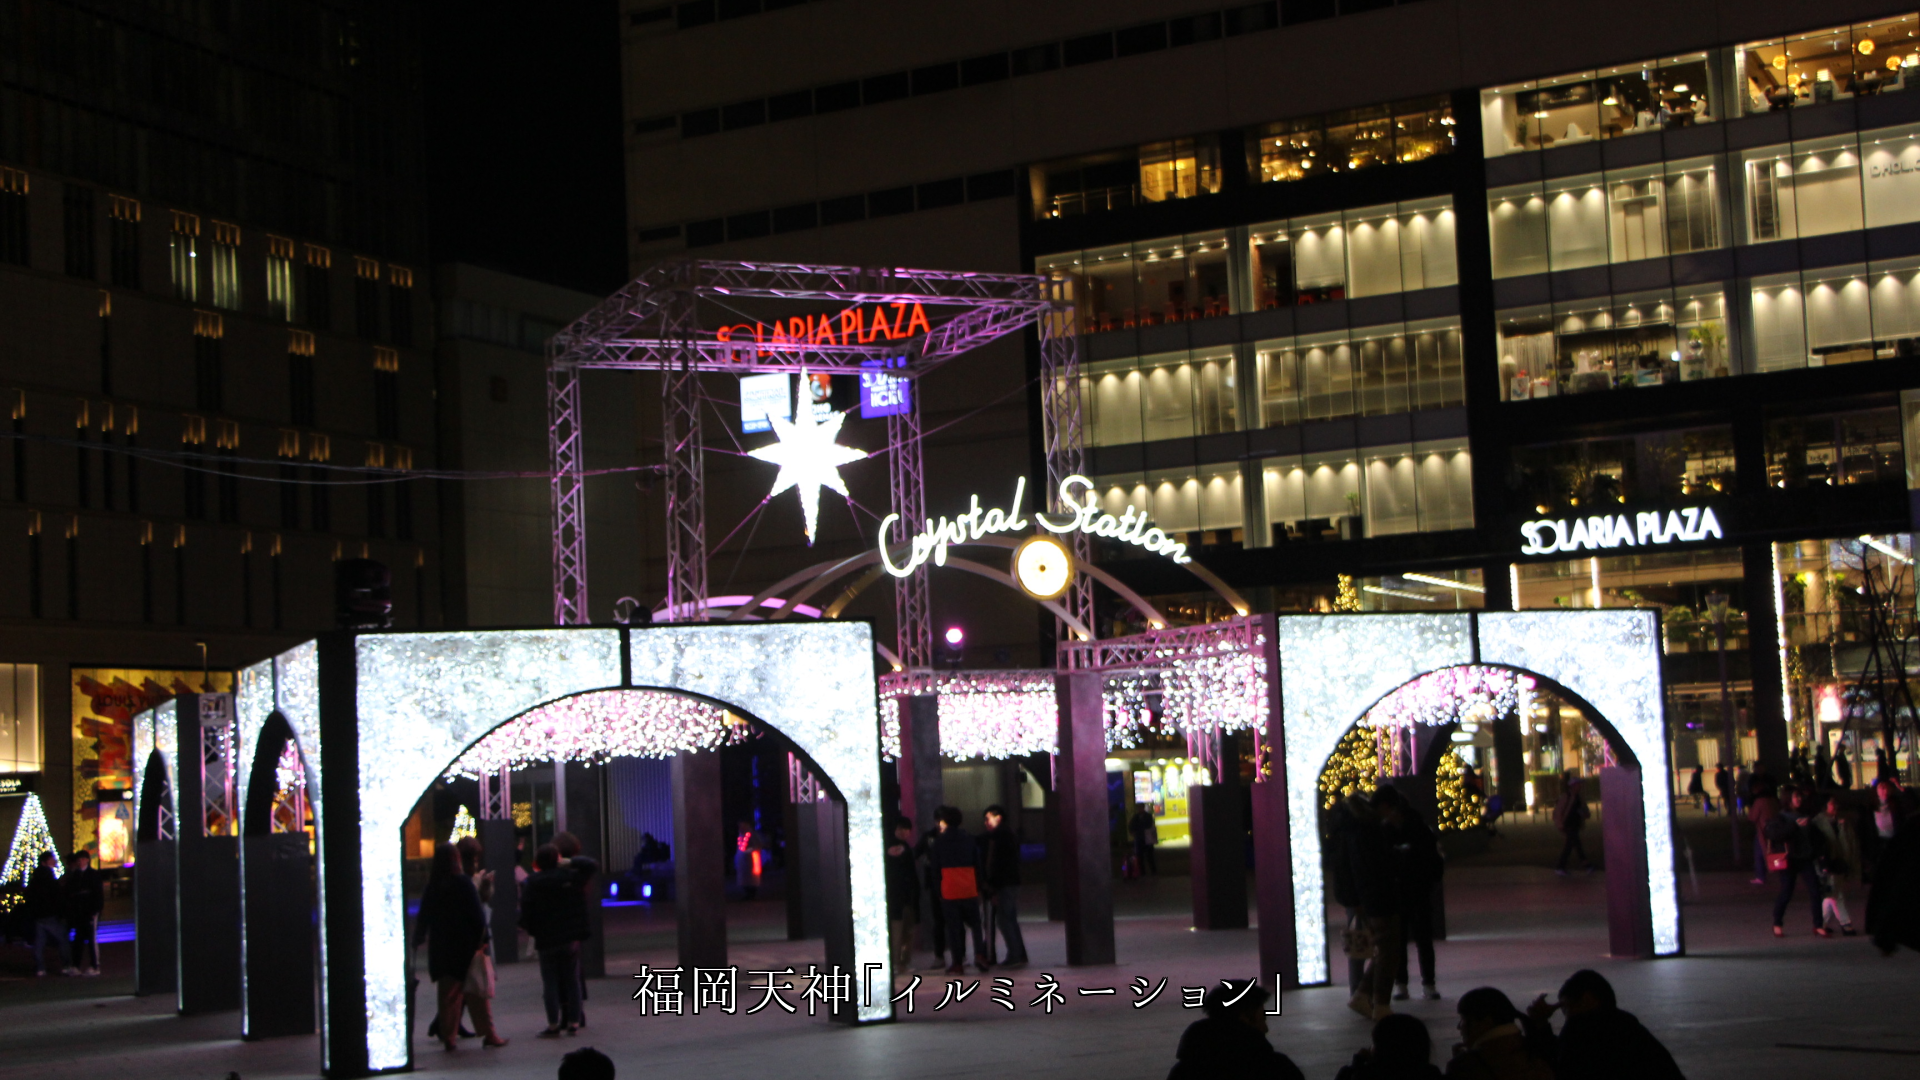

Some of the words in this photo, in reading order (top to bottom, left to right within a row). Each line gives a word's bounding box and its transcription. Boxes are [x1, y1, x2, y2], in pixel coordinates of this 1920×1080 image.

[841, 301, 931, 346] PLAZA
[879, 476, 1027, 577] Crystal
[1035, 474, 1191, 564] Station
[1521, 514, 1635, 555] SOLARIA
[1636, 506, 1723, 546] PLAZA
